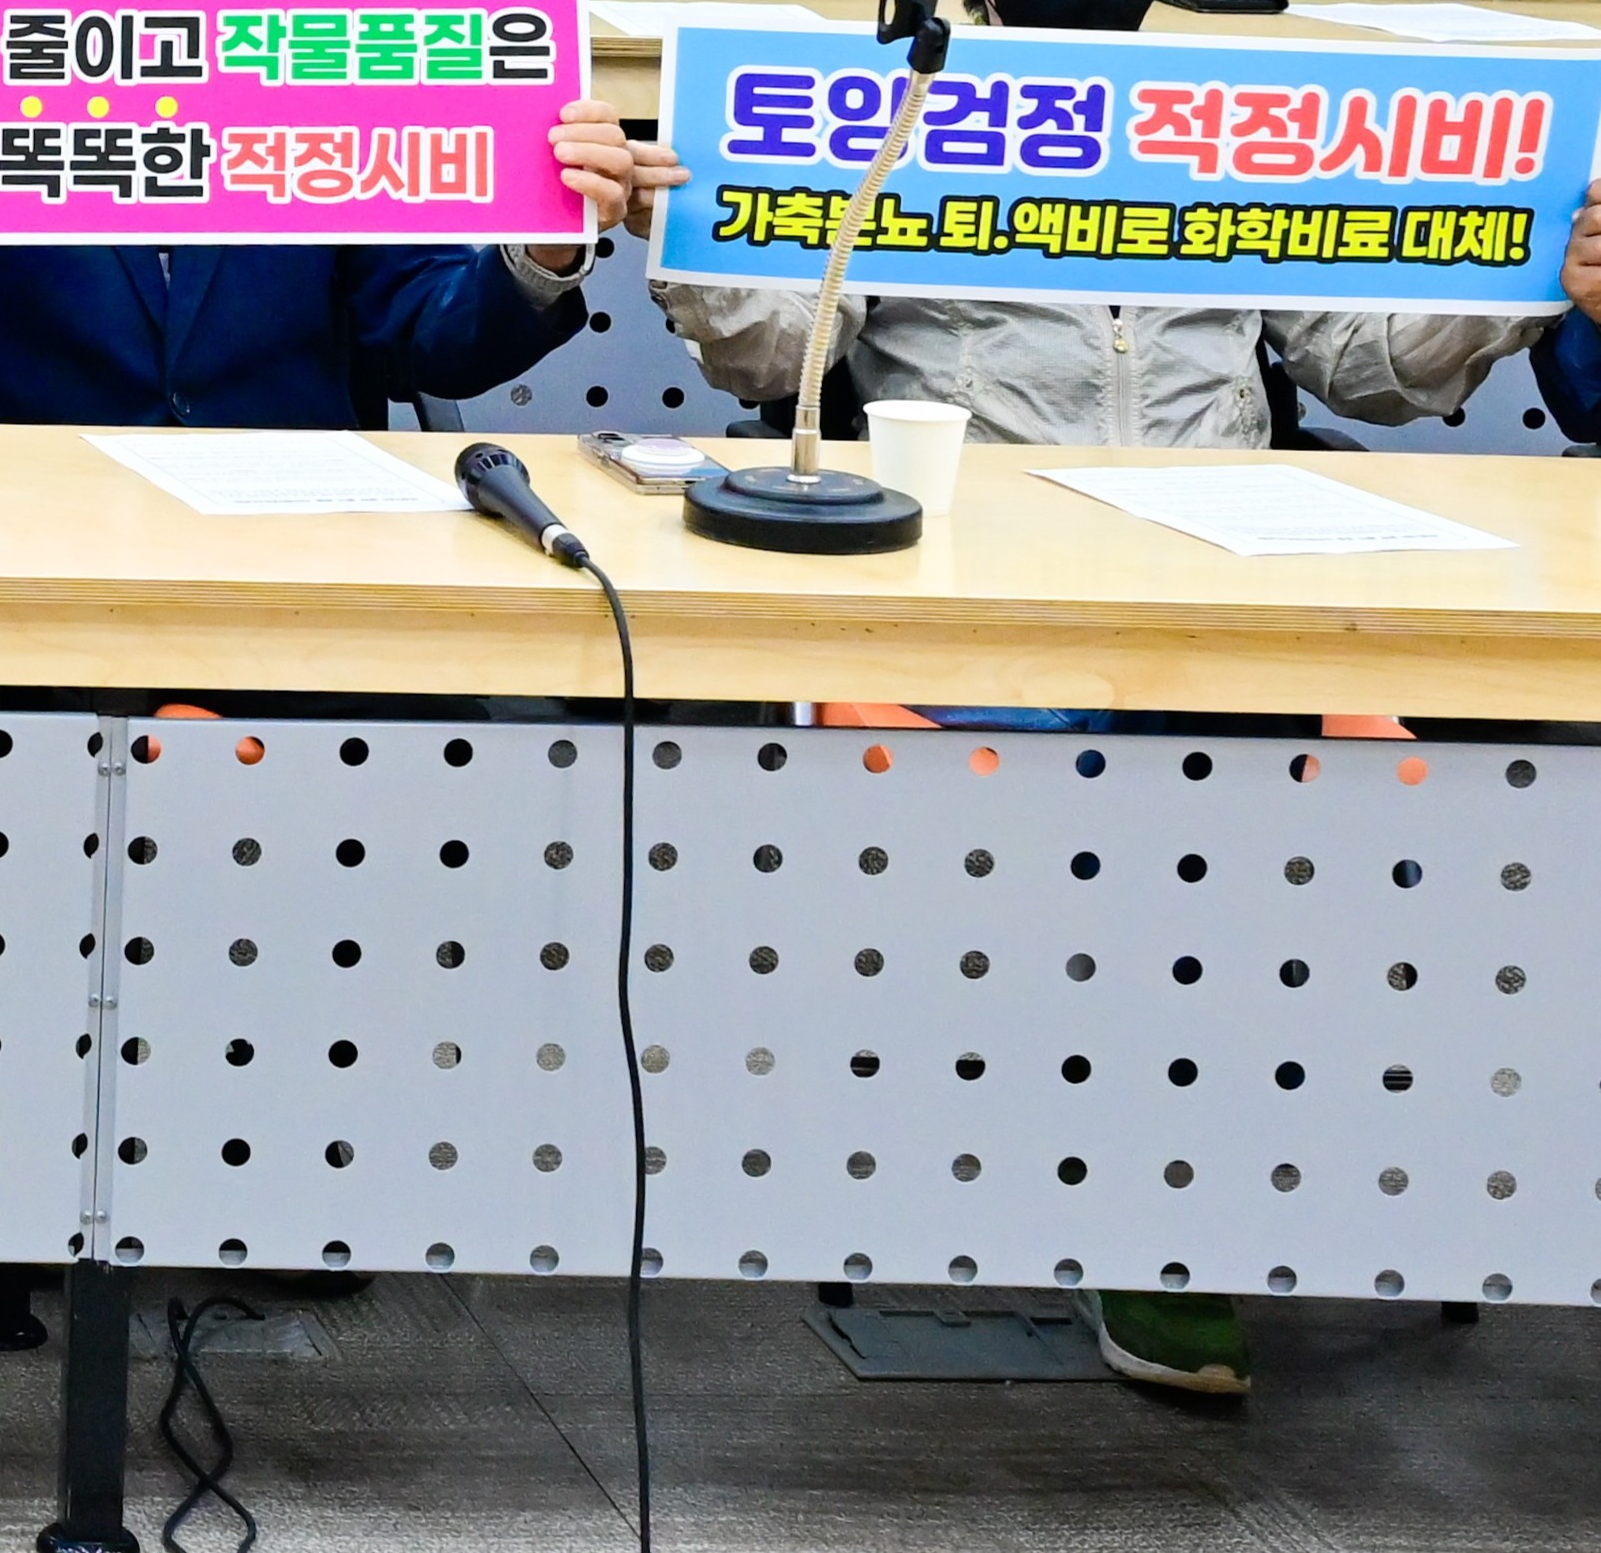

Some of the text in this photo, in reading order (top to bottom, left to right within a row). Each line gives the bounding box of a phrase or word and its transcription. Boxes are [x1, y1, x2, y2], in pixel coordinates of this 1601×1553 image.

[6, 13, 202, 80] 줄이고
[219, 13, 552, 81] 작물품질은
[224, 129, 489, 199] 적정시비
[1132, 86, 1543, 179] 적정시비!
[1178, 207, 1394, 262] 화학비료
[1398, 213, 1530, 268] 대체!
